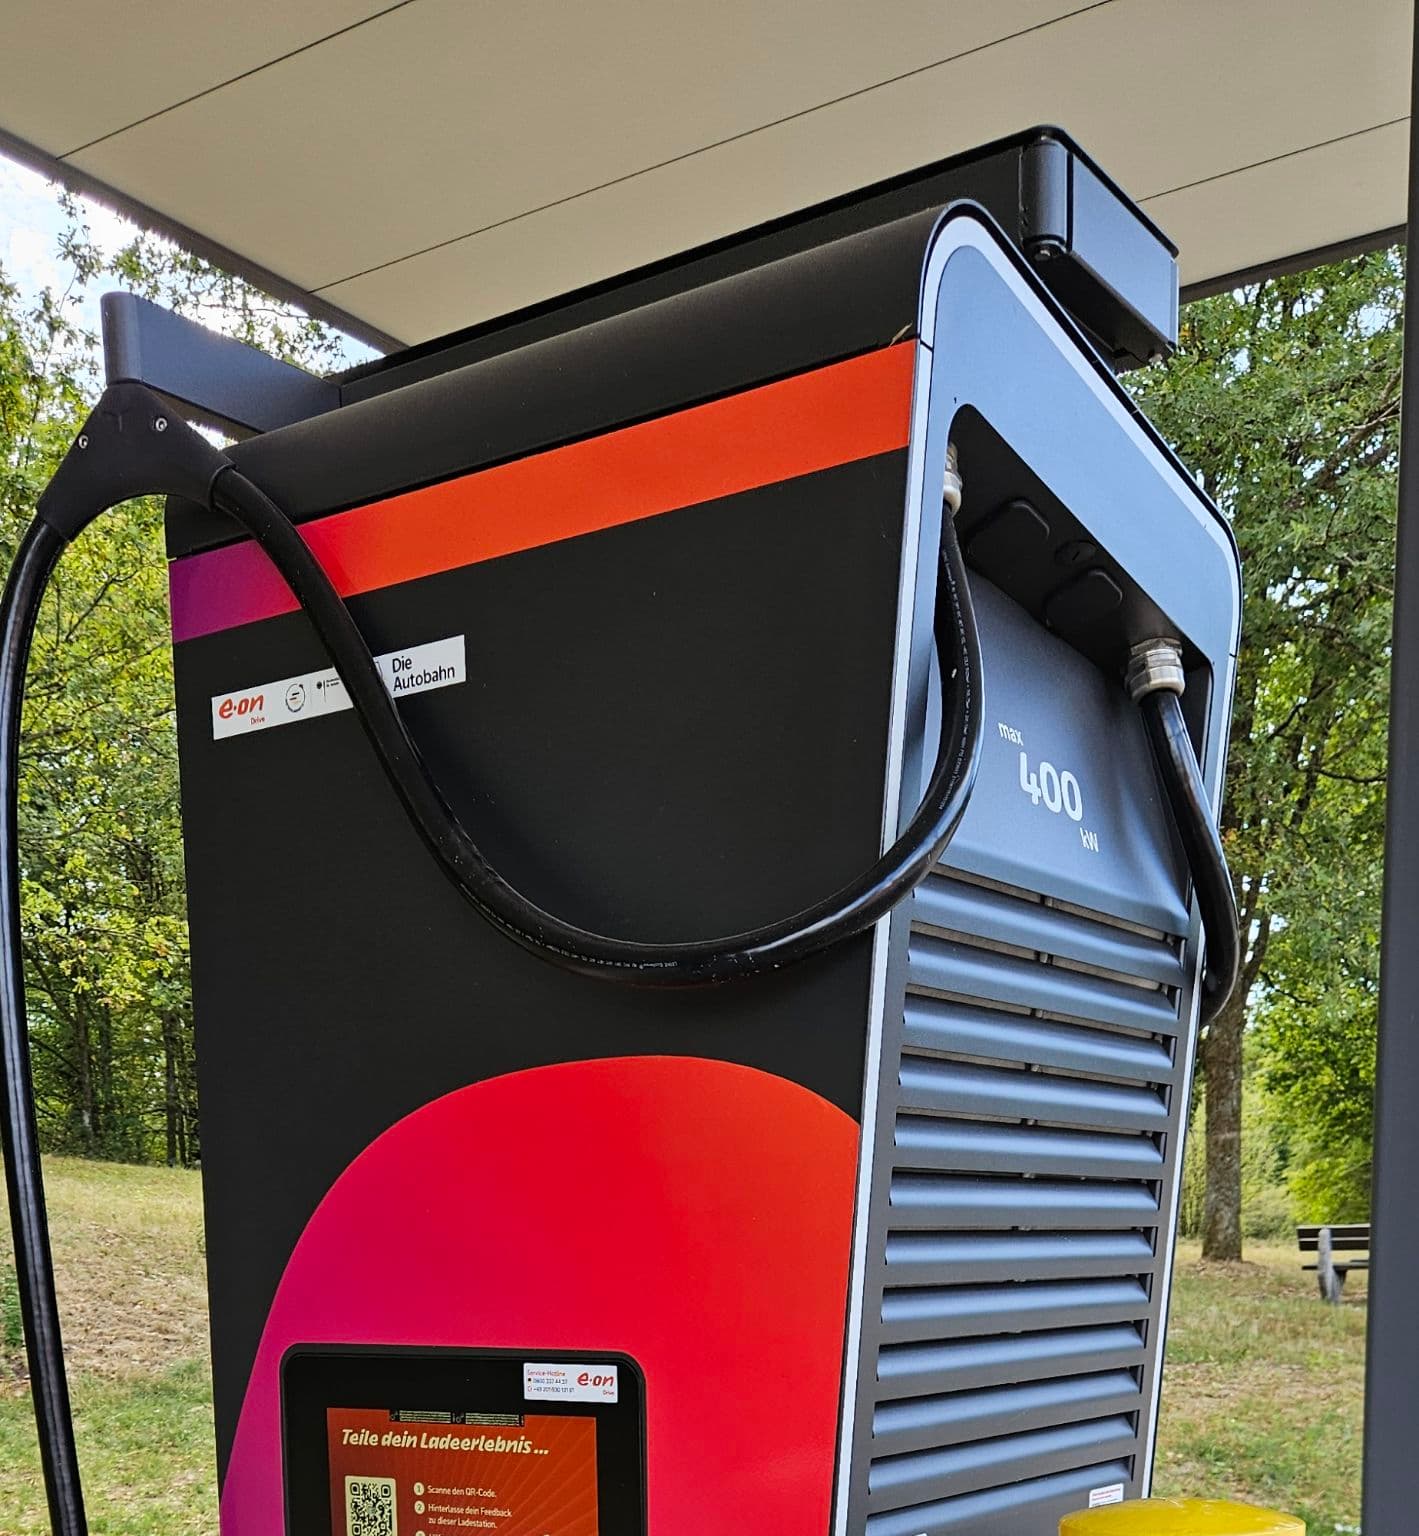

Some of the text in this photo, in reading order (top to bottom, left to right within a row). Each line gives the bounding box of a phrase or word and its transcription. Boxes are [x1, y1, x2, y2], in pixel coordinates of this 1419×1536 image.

[391, 655, 413, 673] Die
[392, 664, 456, 692] Autobahn
[250, 715, 266, 726] Drive
[998, 722, 1024, 746] max
[1019, 751, 1084, 822] 400
[1079, 826, 1100, 853] kW
[342, 1428, 378, 1447] Teile
[381, 1431, 417, 1449] dein
[420, 1432, 532, 1455] Ladeerlebnis
[427, 1485, 451, 1494] Scanne
[451, 1487, 465, 1496] den
[465, 1487, 497, 1498] QR-Code.
[428, 1503, 464, 1514] Hinterlasse
[465, 1505, 480, 1515] dein
[480, 1506, 513, 1517] Feedback
[437, 1516, 457, 1526] dieser
[458, 1517, 498, 1529] Ladestation.
